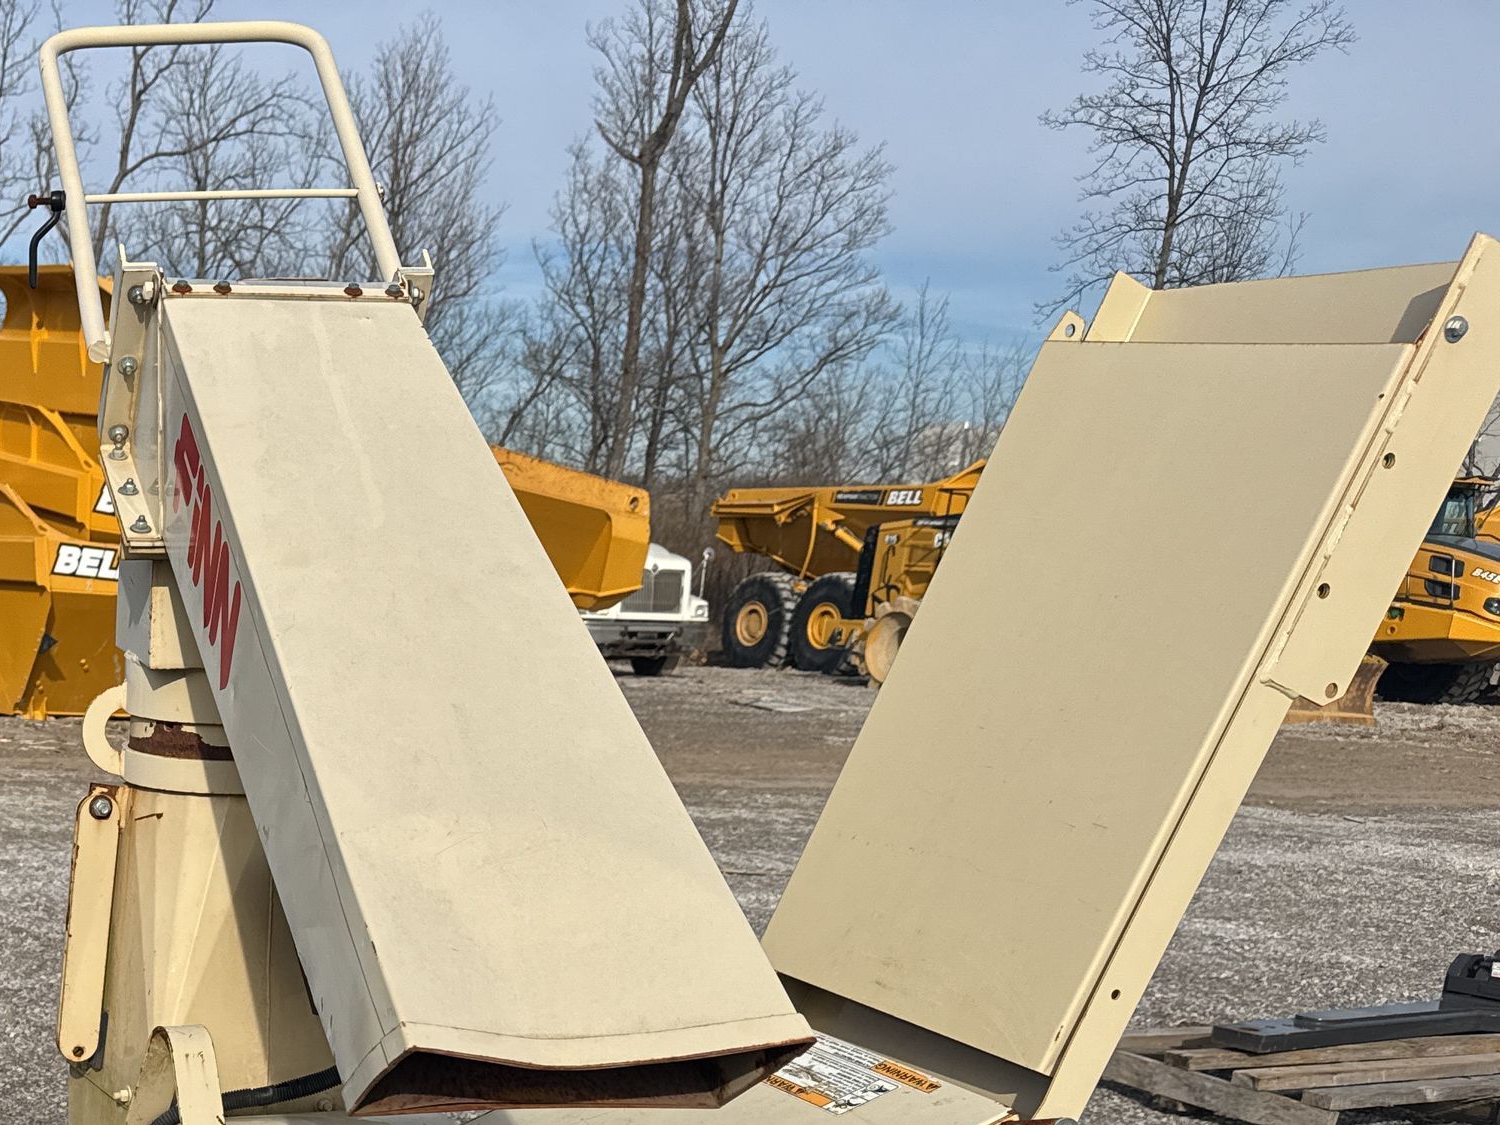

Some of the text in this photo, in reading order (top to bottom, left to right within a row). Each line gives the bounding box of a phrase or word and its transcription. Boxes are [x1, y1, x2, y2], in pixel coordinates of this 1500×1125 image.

[887, 490, 922, 505] BELL
[53, 544, 119, 580] BEL
[767, 1076, 800, 1094] WARN
[875, 1061, 928, 1090] WARNING
